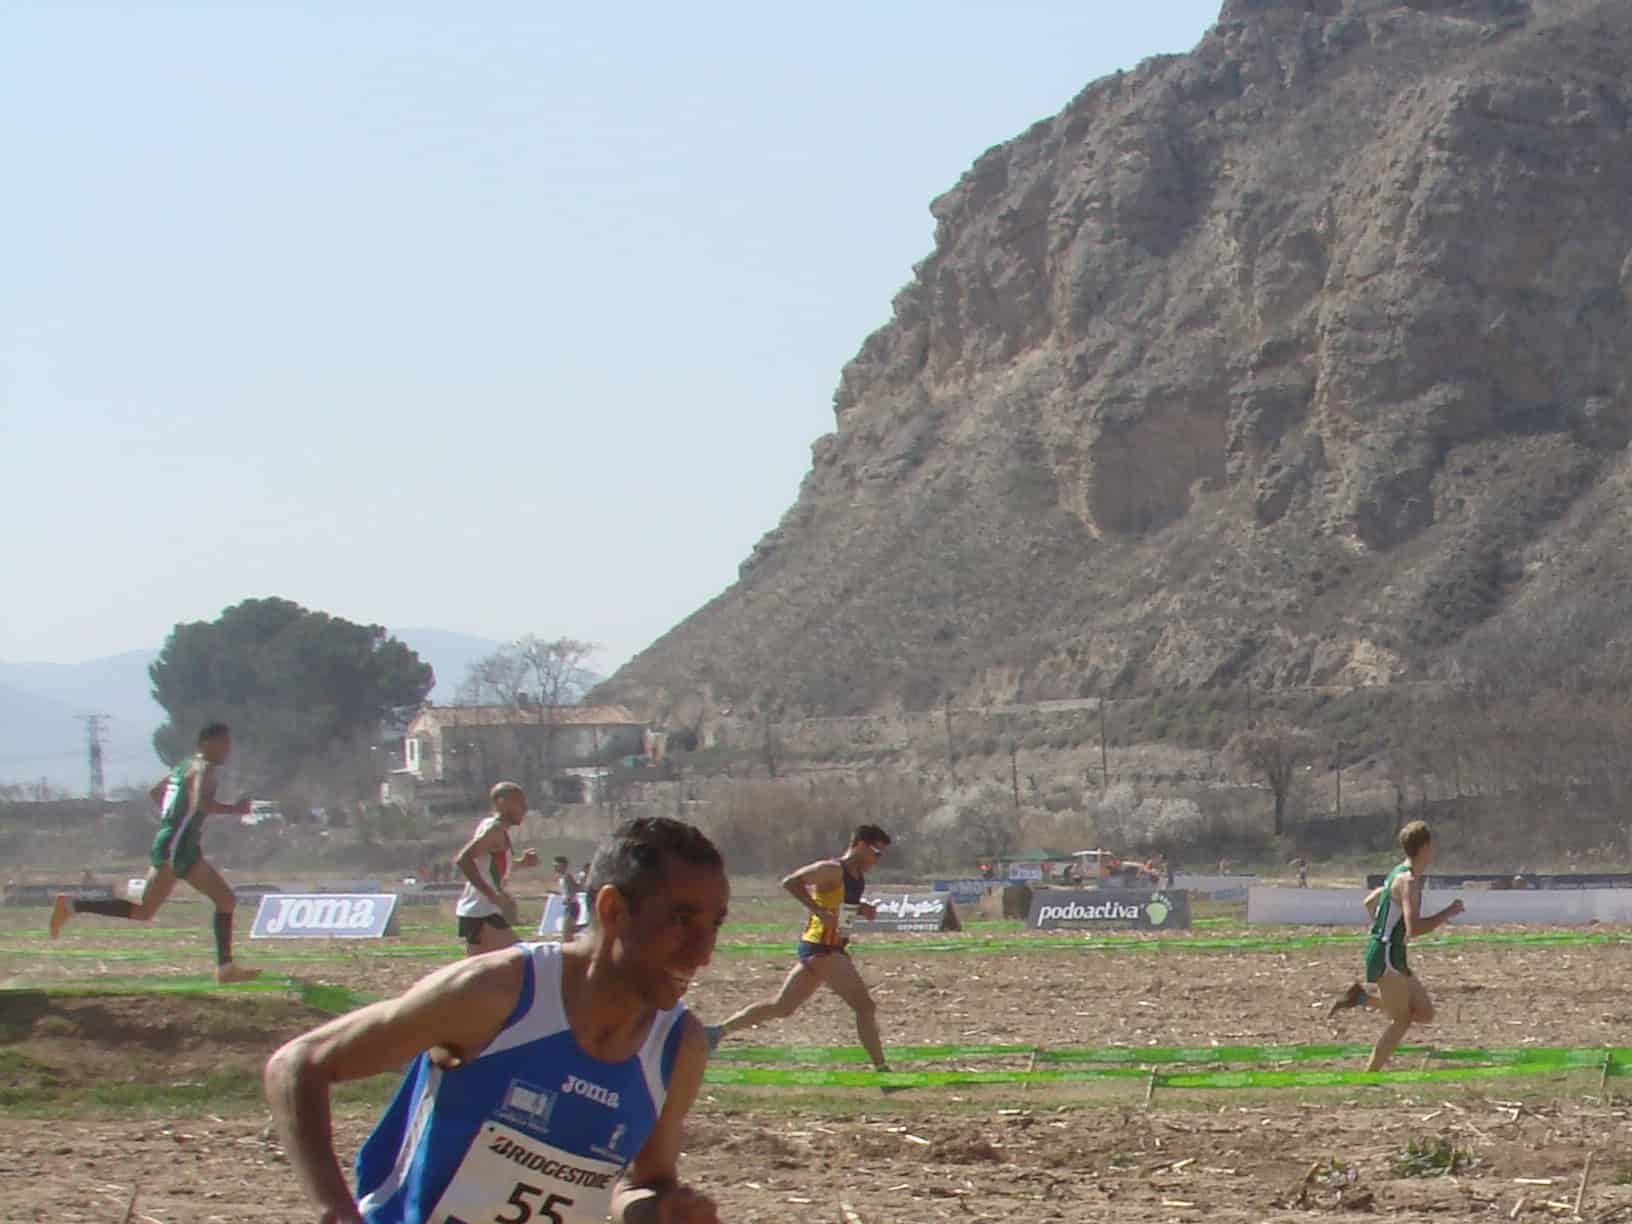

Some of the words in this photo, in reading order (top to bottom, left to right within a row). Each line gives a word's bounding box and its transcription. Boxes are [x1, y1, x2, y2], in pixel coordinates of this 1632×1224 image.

[267, 898, 375, 933] Joma
[1036, 899, 1139, 927] podoactiva
[561, 1074, 620, 1109] Joma
